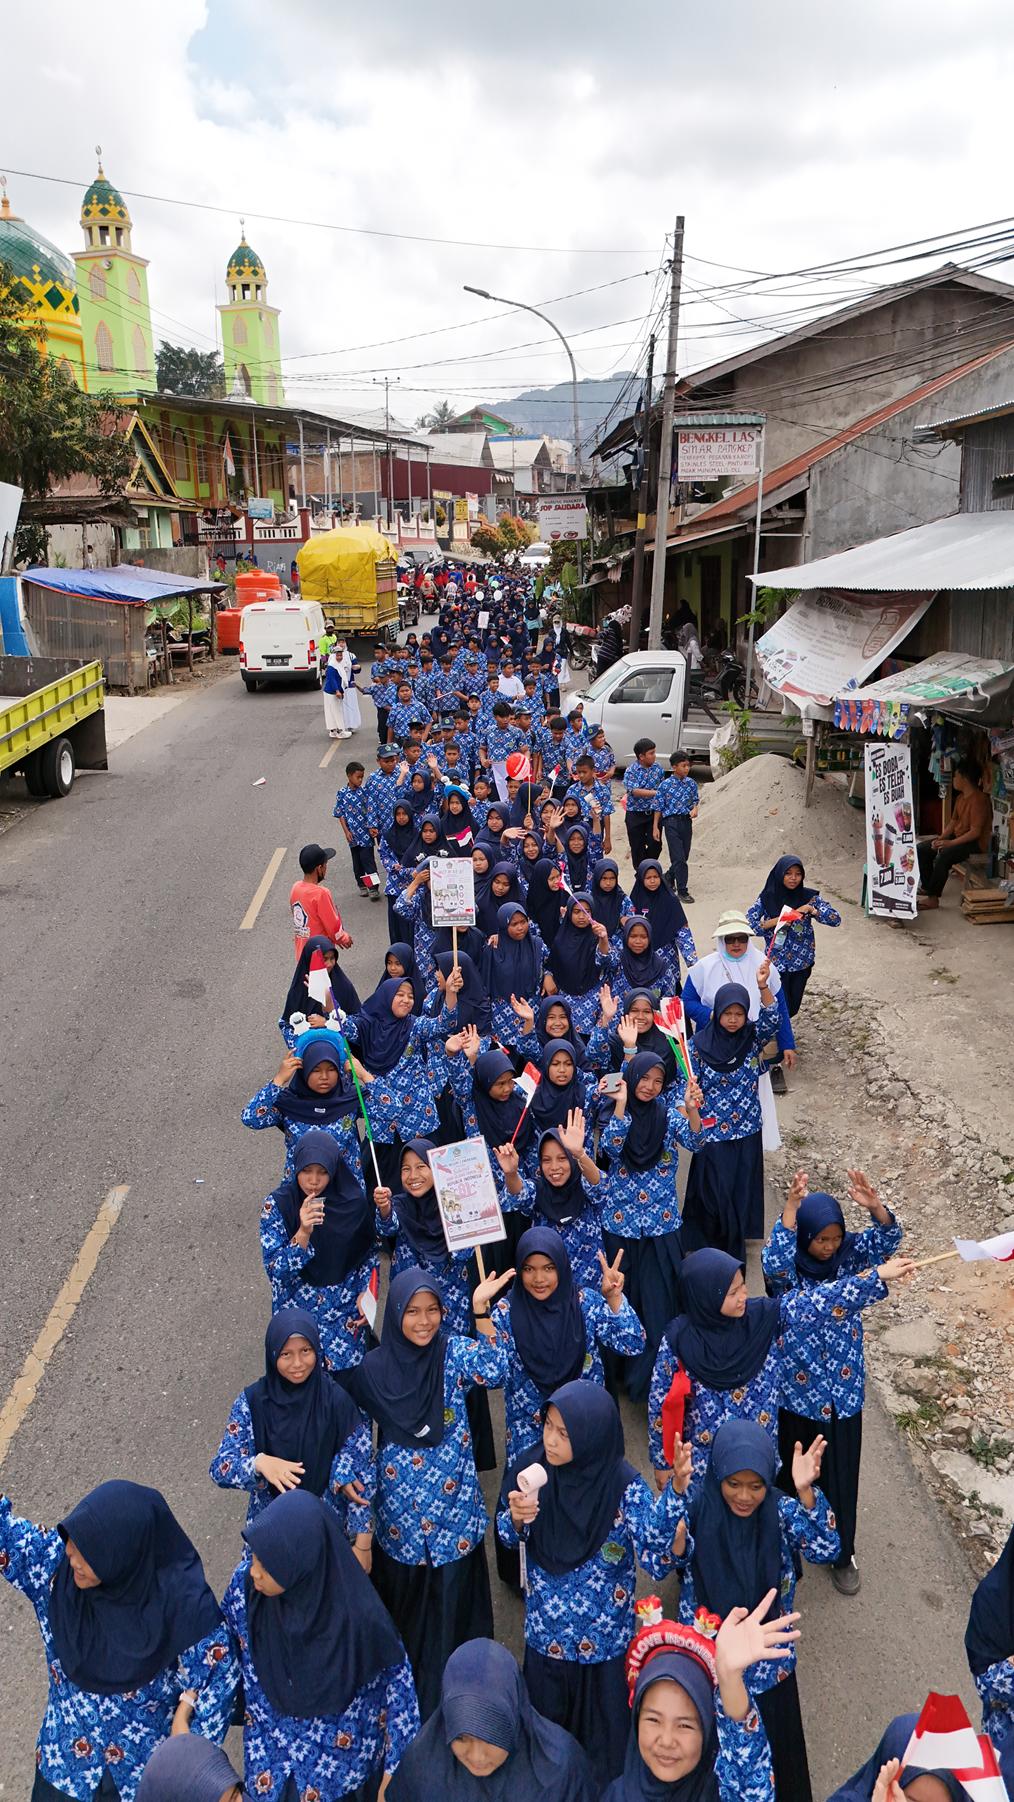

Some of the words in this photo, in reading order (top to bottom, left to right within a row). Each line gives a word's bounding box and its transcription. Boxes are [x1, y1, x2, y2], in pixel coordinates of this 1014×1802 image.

[680, 431, 730, 444] BENGKEL
[733, 431, 755, 443] LAS
[554, 502, 586, 511] SAUDARA
[875, 762, 882, 780] ES
[882, 755, 899, 776] BOBA
[879, 776, 886, 793] ES
[887, 769, 905, 790] TELER
[884, 790, 890, 805] ES
[891, 785, 905, 802] BUAH
[631, 1631, 664, 1661] LOVE
[629, 1658, 641, 1667] I
